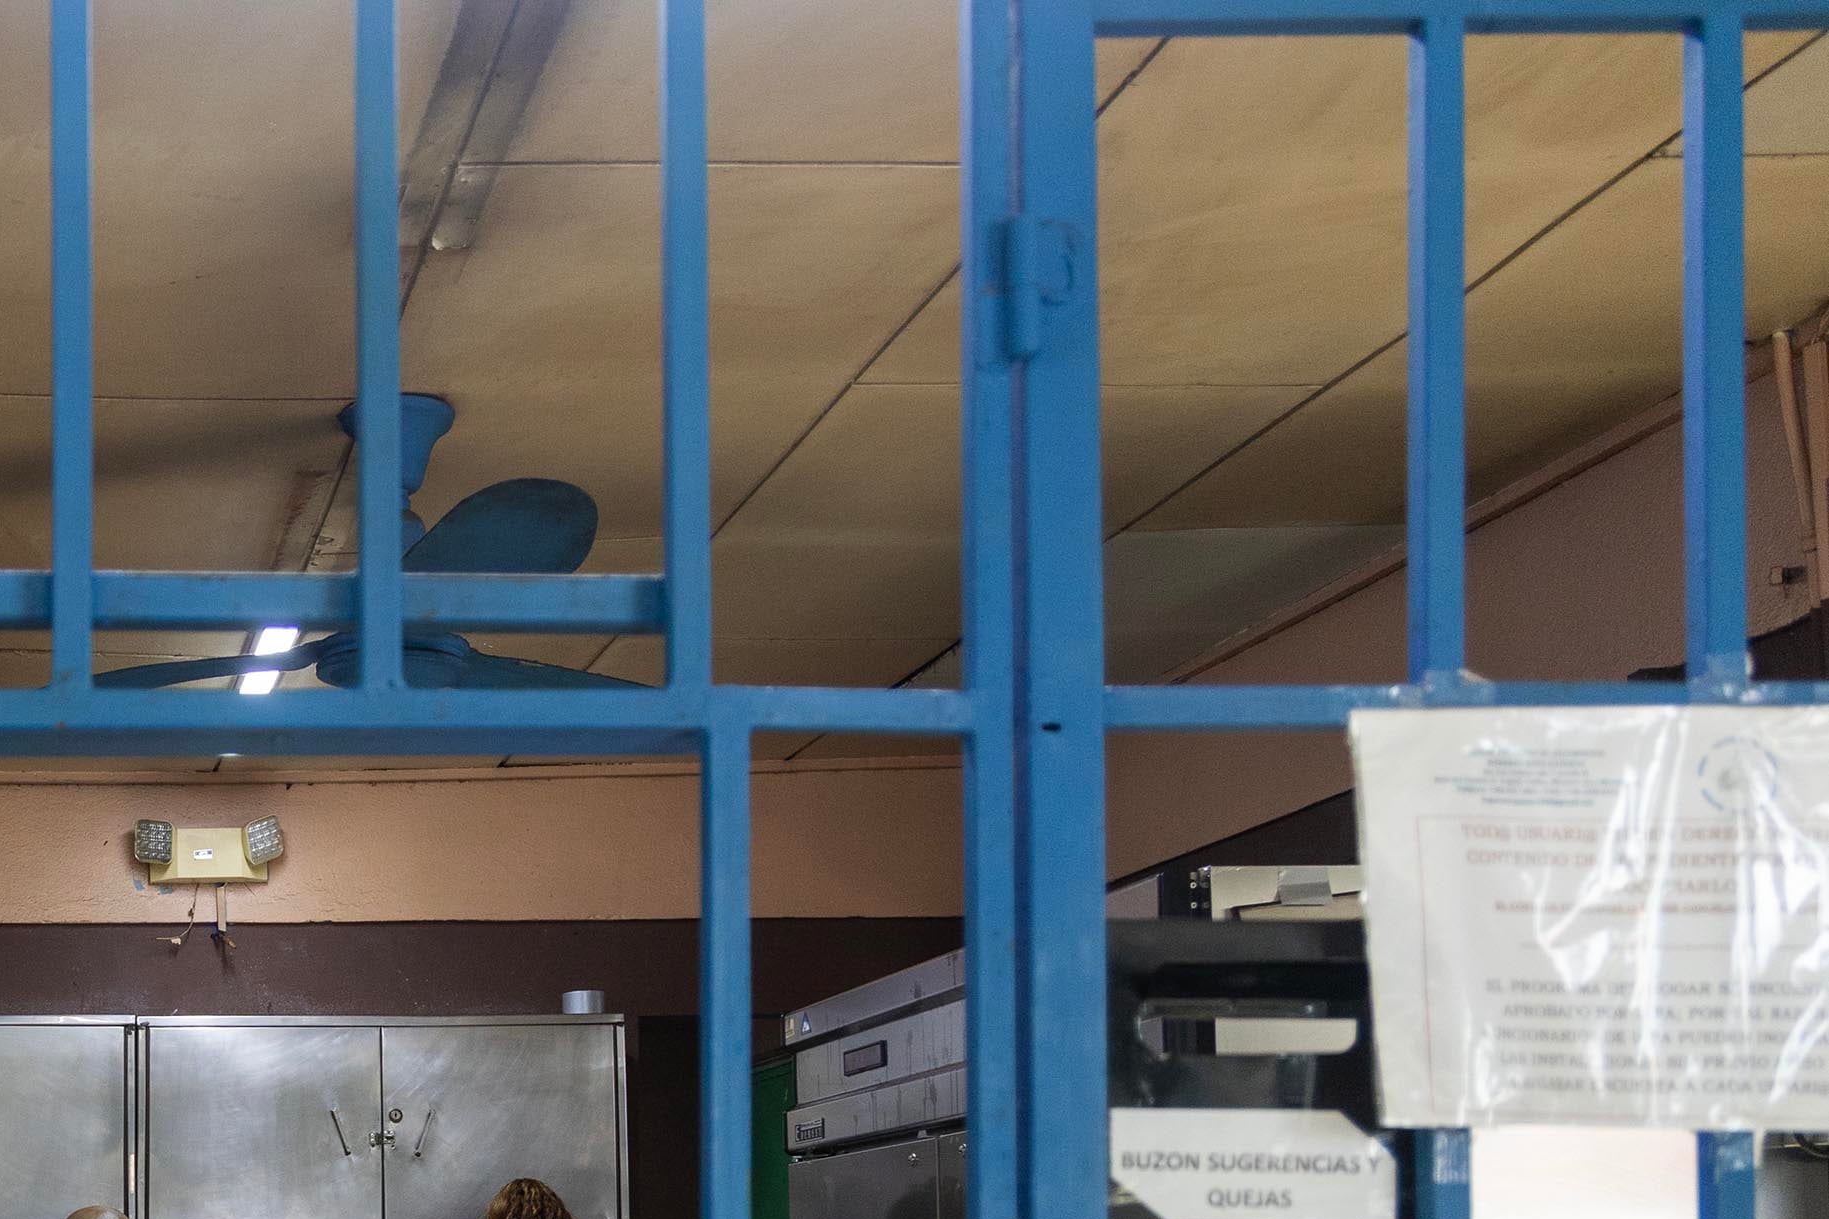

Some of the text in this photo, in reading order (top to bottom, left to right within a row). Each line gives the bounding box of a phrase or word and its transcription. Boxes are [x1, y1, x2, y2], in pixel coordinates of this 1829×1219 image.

[1510, 979, 1601, 996] PROGRMA
[1207, 1152, 1361, 1174] SUGERENCIAS
[1367, 1155, 1383, 1174] Y
[1206, 1188, 1293, 1209] QUEJAS
